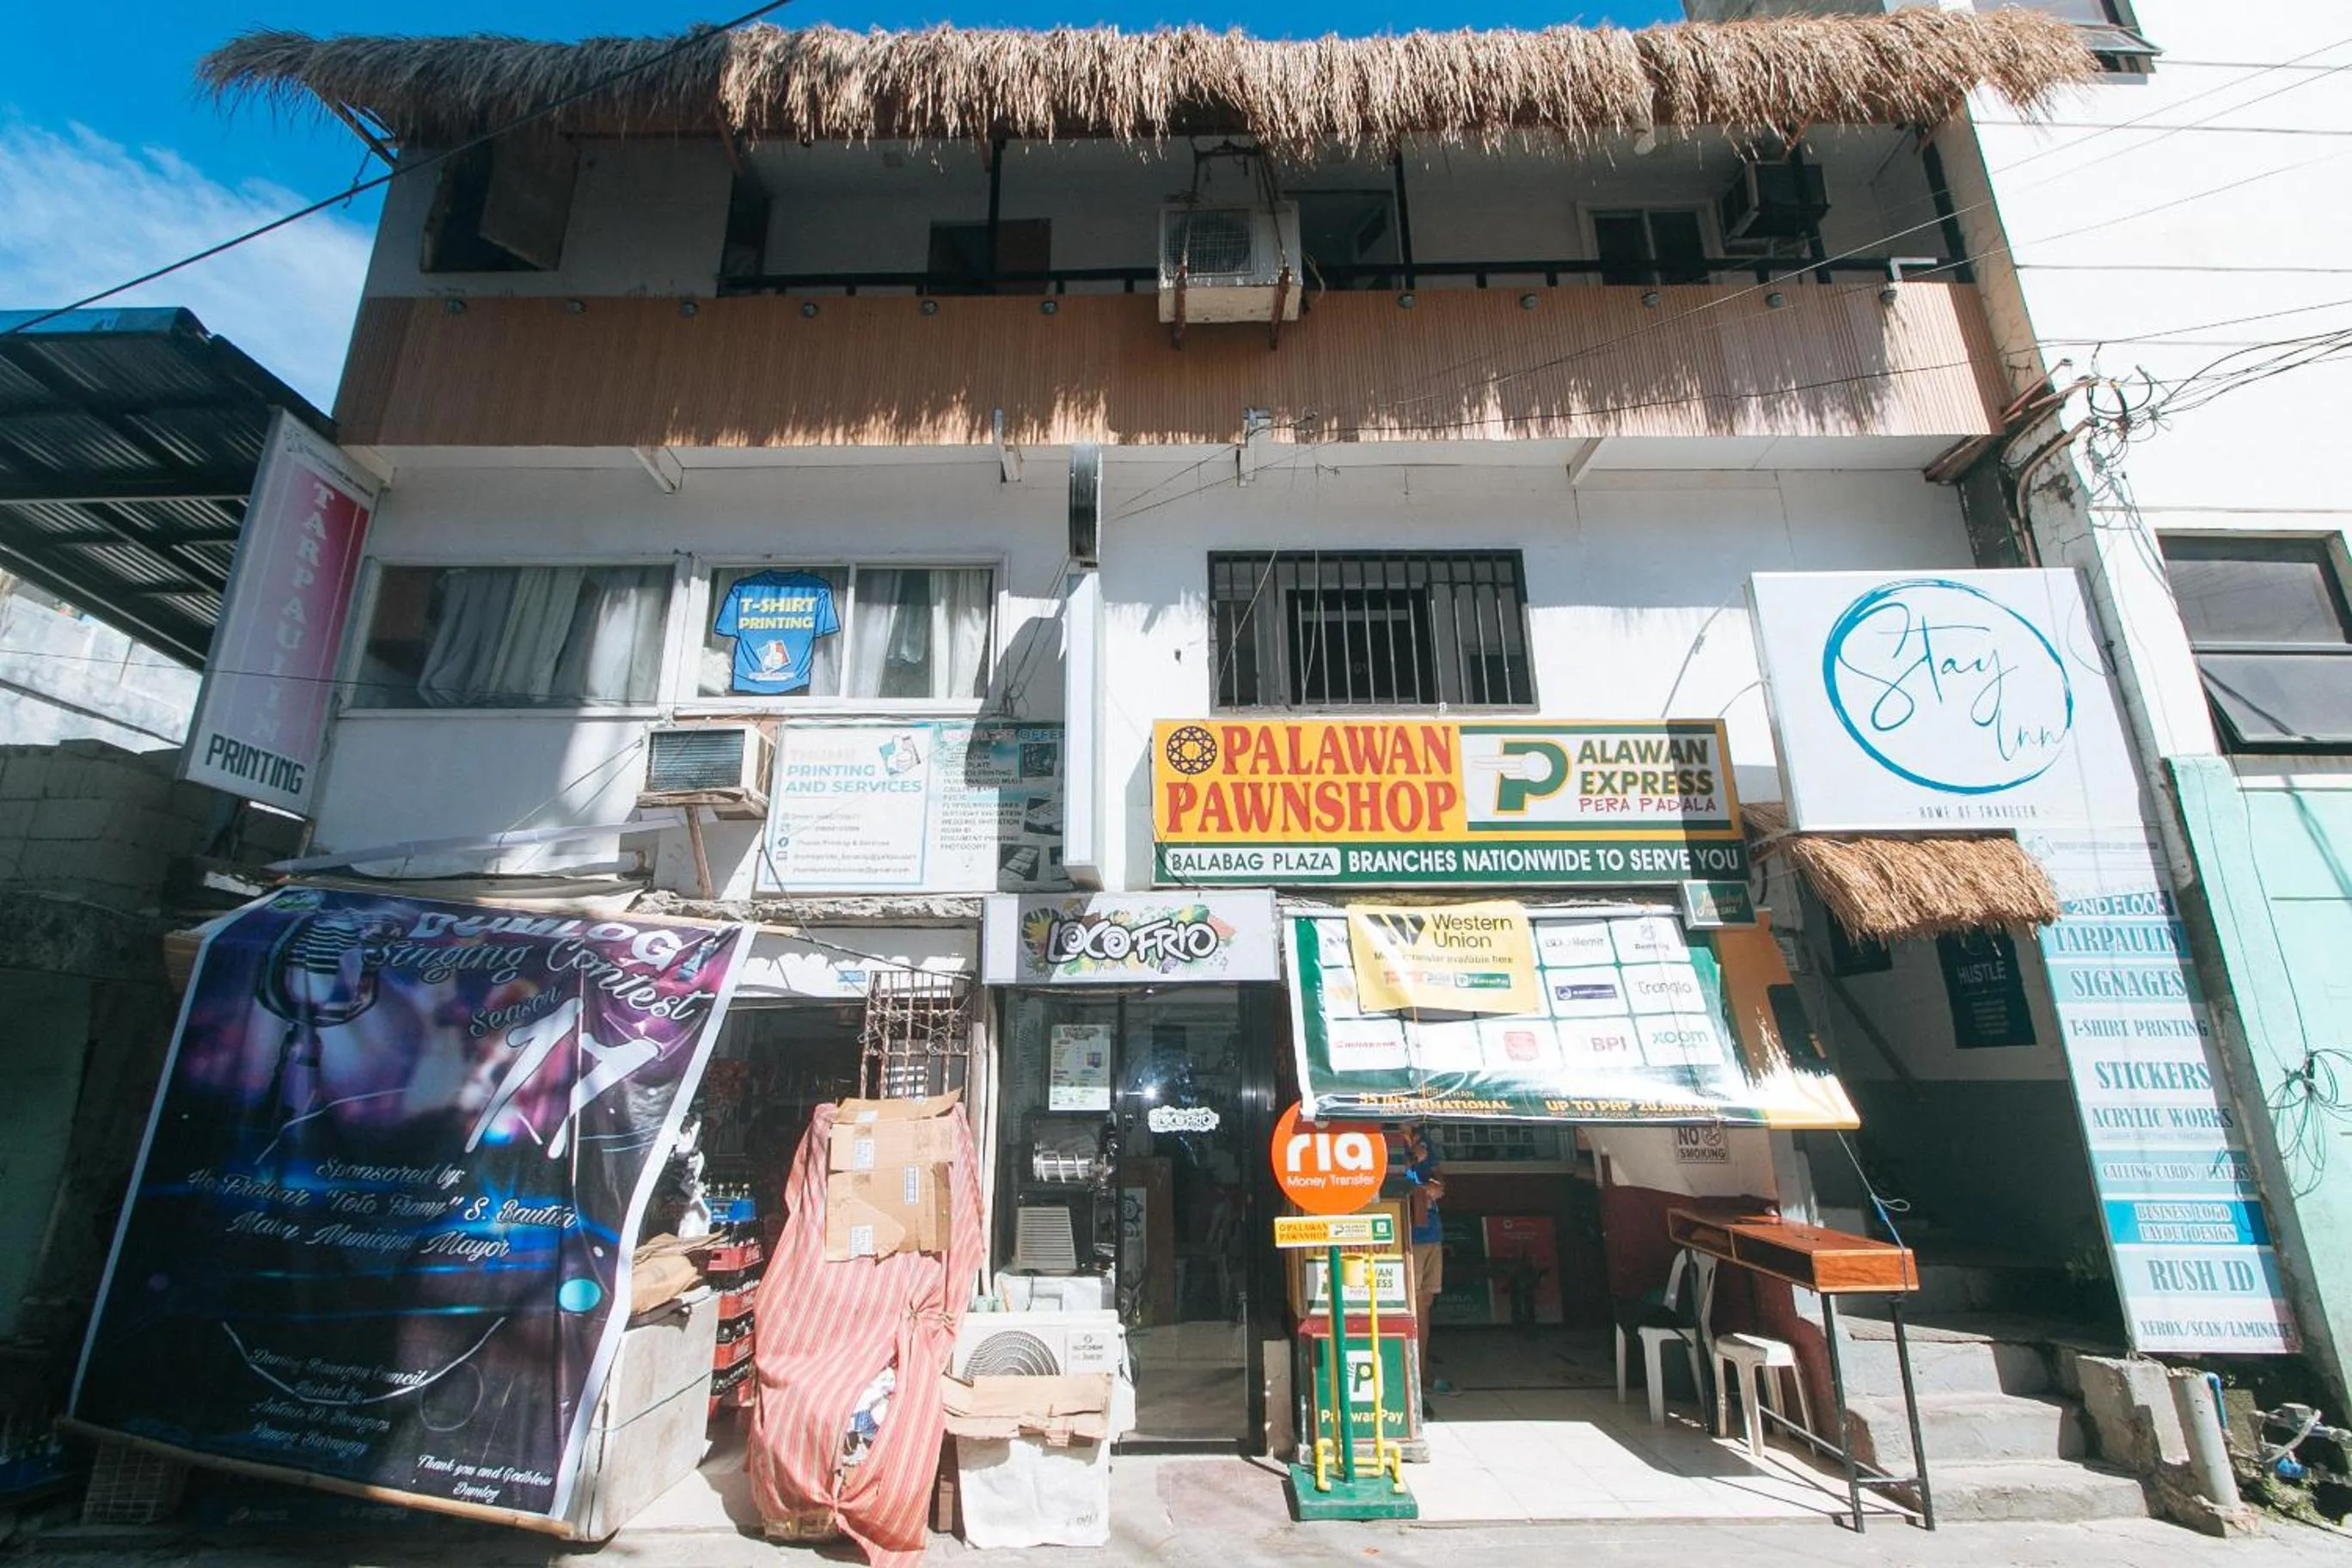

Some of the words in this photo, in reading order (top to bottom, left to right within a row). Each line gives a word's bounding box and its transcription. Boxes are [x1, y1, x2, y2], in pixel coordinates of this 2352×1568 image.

[740, 597, 817, 613] T-SHIRT
[738, 616, 815, 629] PRINTING
[1836, 602, 2018, 732] Stay
[1221, 725, 1454, 775] PALAWAN
[1577, 738, 1708, 765] ALAWAN
[205, 732, 307, 794] PRINTING
[787, 764, 875, 777] PRINTING
[786, 780, 826, 793] AND
[831, 780, 922, 793] SERVICES
[1580, 769, 1715, 796] EXPRESS
[1166, 780, 1458, 833] PAWNSHOP
[1578, 797, 1631, 813] PERA
[1639, 797, 1717, 812] PADALA
[1172, 851, 1264, 872] BALABAG
[1272, 851, 1334, 872] PLAZA
[1348, 850, 1456, 873] BRANCHES
[1463, 849, 1592, 873] NATIONWIDE
[1596, 849, 1627, 872] TO
[1631, 848, 1691, 871] SERVE
[1694, 848, 1739, 870] YOU
[1430, 913, 1513, 931] Western
[1433, 930, 1492, 949] Union
[2050, 926, 2181, 952] TARPAULIN
[374, 940, 538, 984] Singing
[546, 937, 715, 1020] Contest
[1957, 960, 2007, 984] HUSTLE
[2070, 969, 2187, 996] SIGNAGES
[469, 986, 561, 1038] Season
[2069, 1019, 2130, 1037] T-SHIRT
[2133, 1019, 2208, 1037] PRINTING
[1590, 1035, 1627, 1051] BPI
[2093, 1060, 2213, 1090] STICKERS
[1545, 1099, 1570, 1112] UP
[1570, 1099, 1596, 1112] TO
[1599, 1099, 1632, 1112] PHP
[2090, 1106, 2165, 1129] ACRYLIC
[2168, 1105, 2235, 1128] WORKS
[1677, 1127, 1699, 1146] NO
[1286, 1131, 1375, 1172] ria
[1679, 1148, 1727, 1160] SMOKING
[315, 1156, 434, 1185] Sponsored
[1286, 1175, 1326, 1189] Money
[1330, 1174, 1375, 1186] Transfer
[419, 1229, 512, 1262] Mayor
[2147, 1259, 2219, 1291] RUSH
[2222, 1259, 2256, 1291] ID
[417, 1454, 456, 1472] Thank
[452, 1463, 476, 1477] you
[476, 1466, 505, 1479] and
